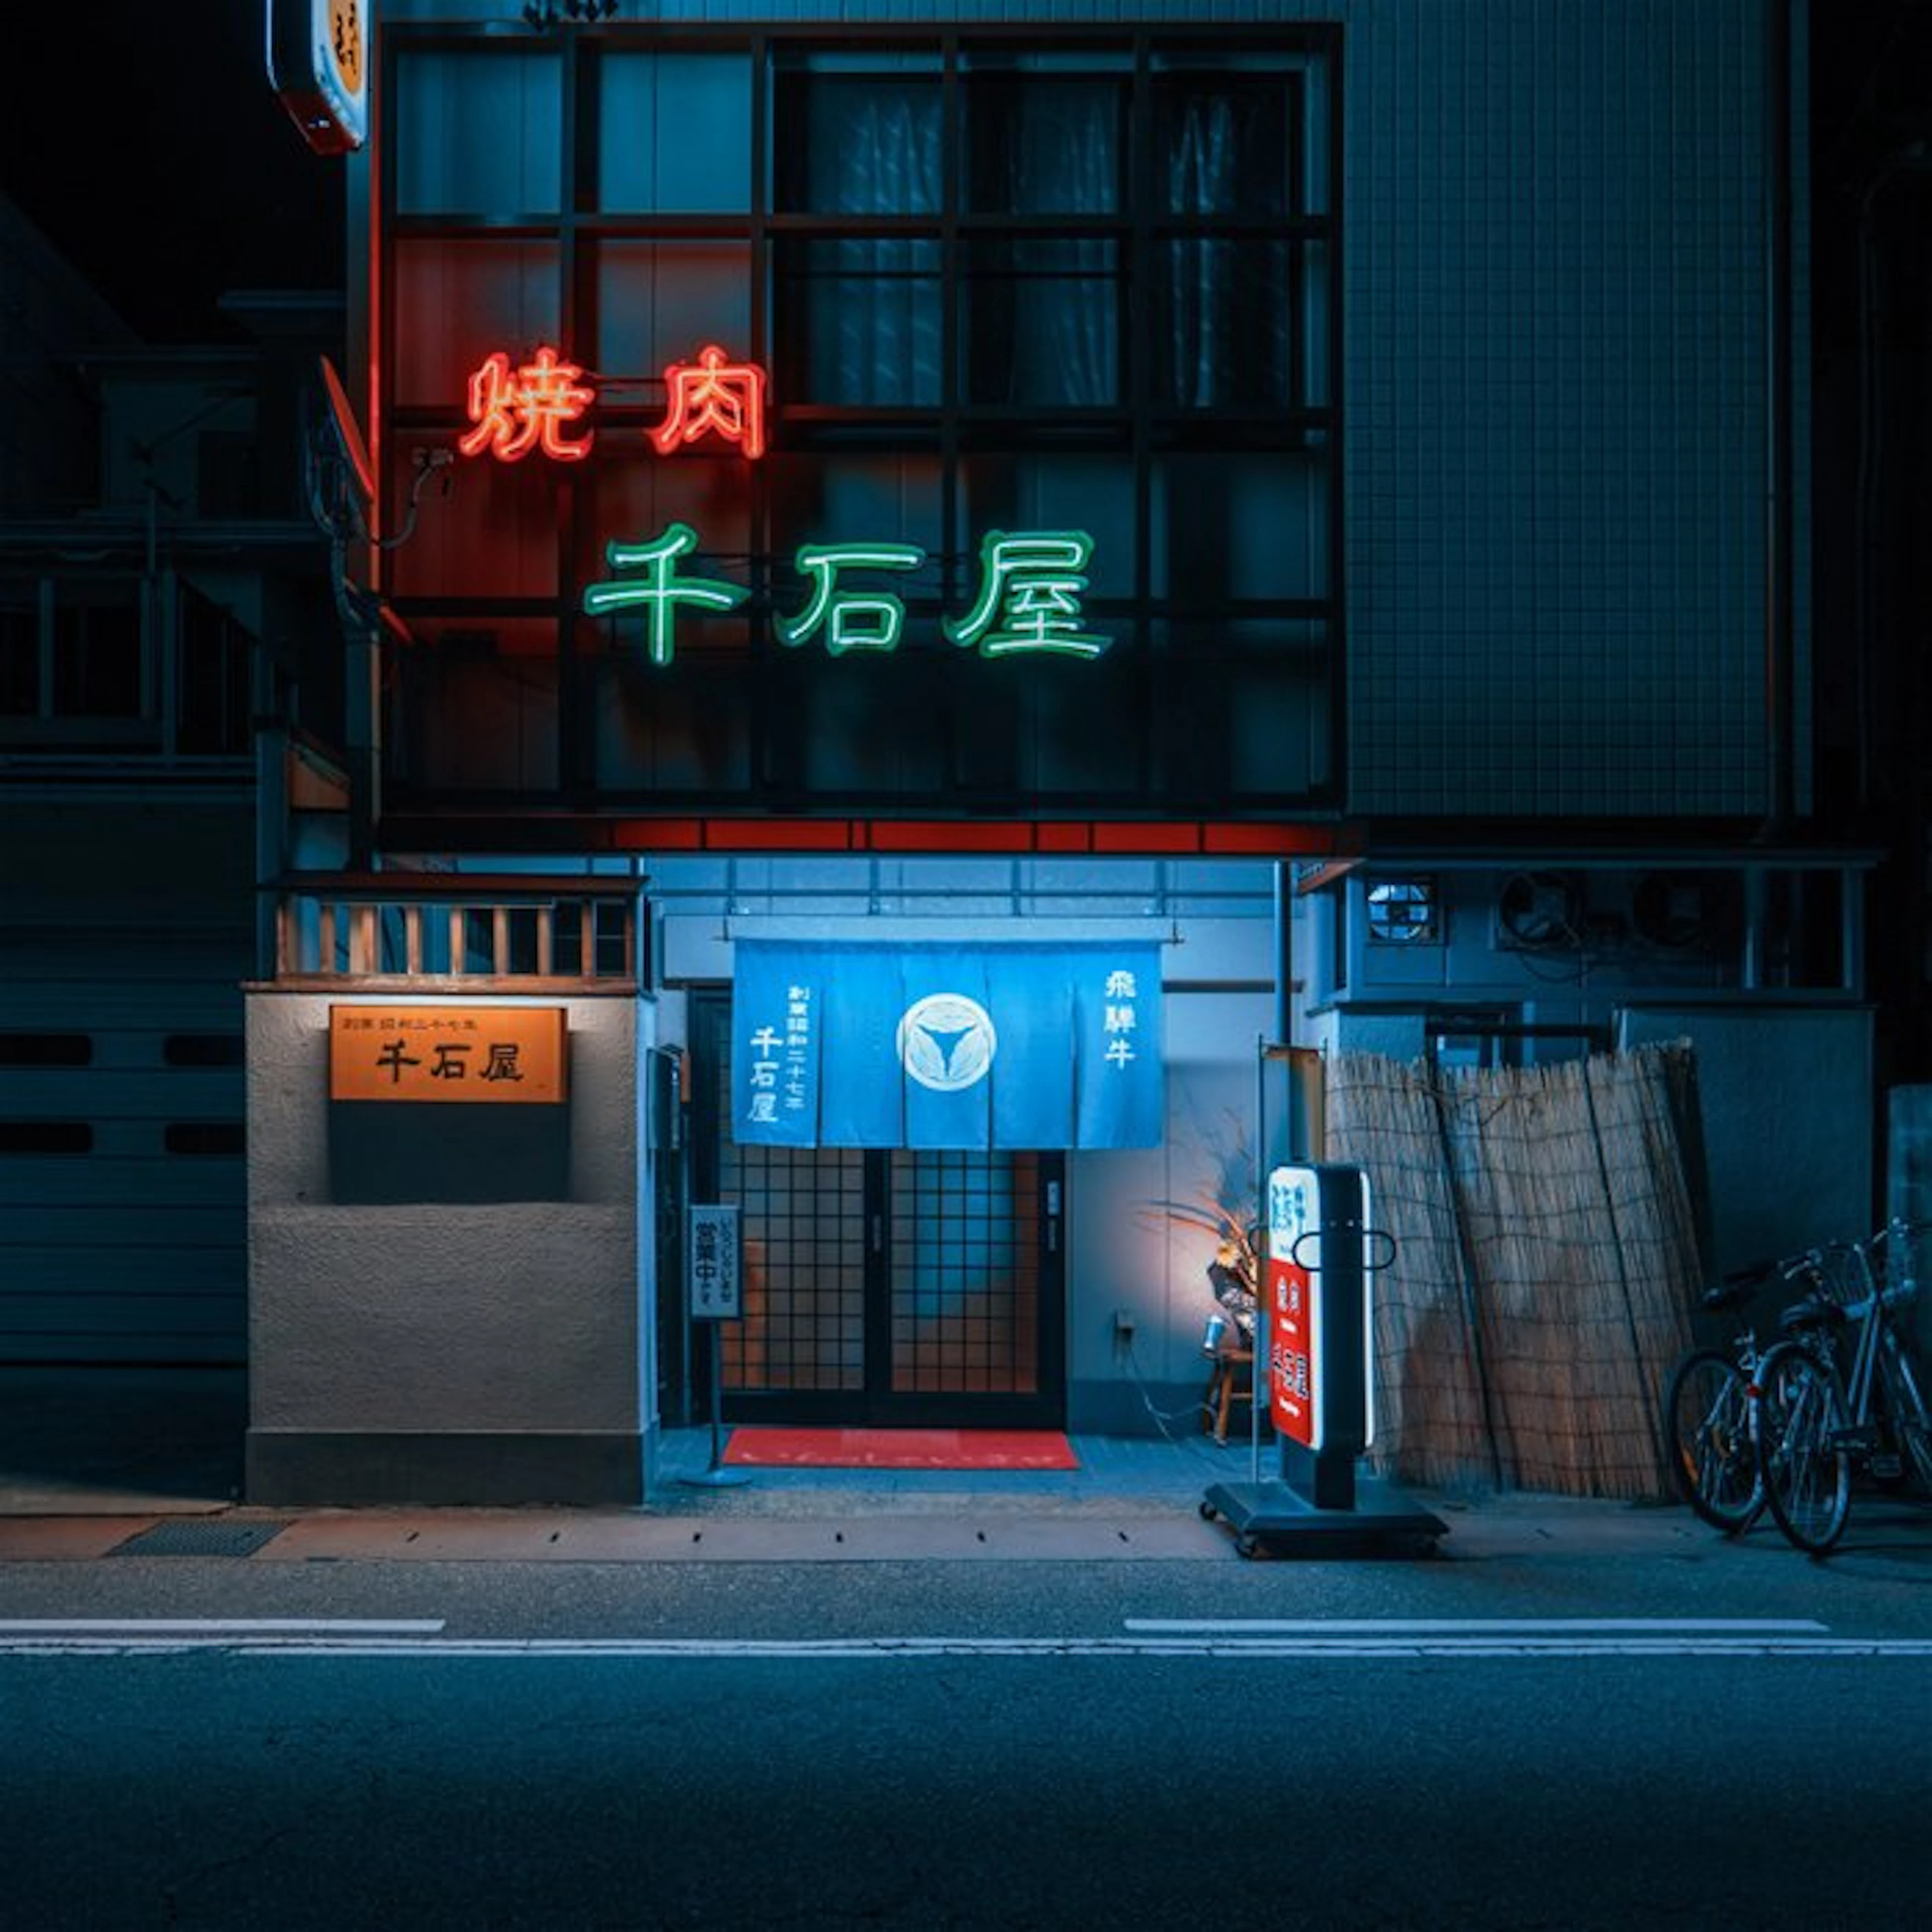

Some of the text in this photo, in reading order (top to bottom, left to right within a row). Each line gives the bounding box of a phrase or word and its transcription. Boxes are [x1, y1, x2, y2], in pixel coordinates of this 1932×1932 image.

[459, 346, 766, 460] 焼肉
[585, 523, 1113, 664] 千石屋
[376, 1038, 524, 1083] 千石屋
[1103, 970, 1137, 1070] 飛騨牛
[747, 1025, 784, 1122] 千石屋
